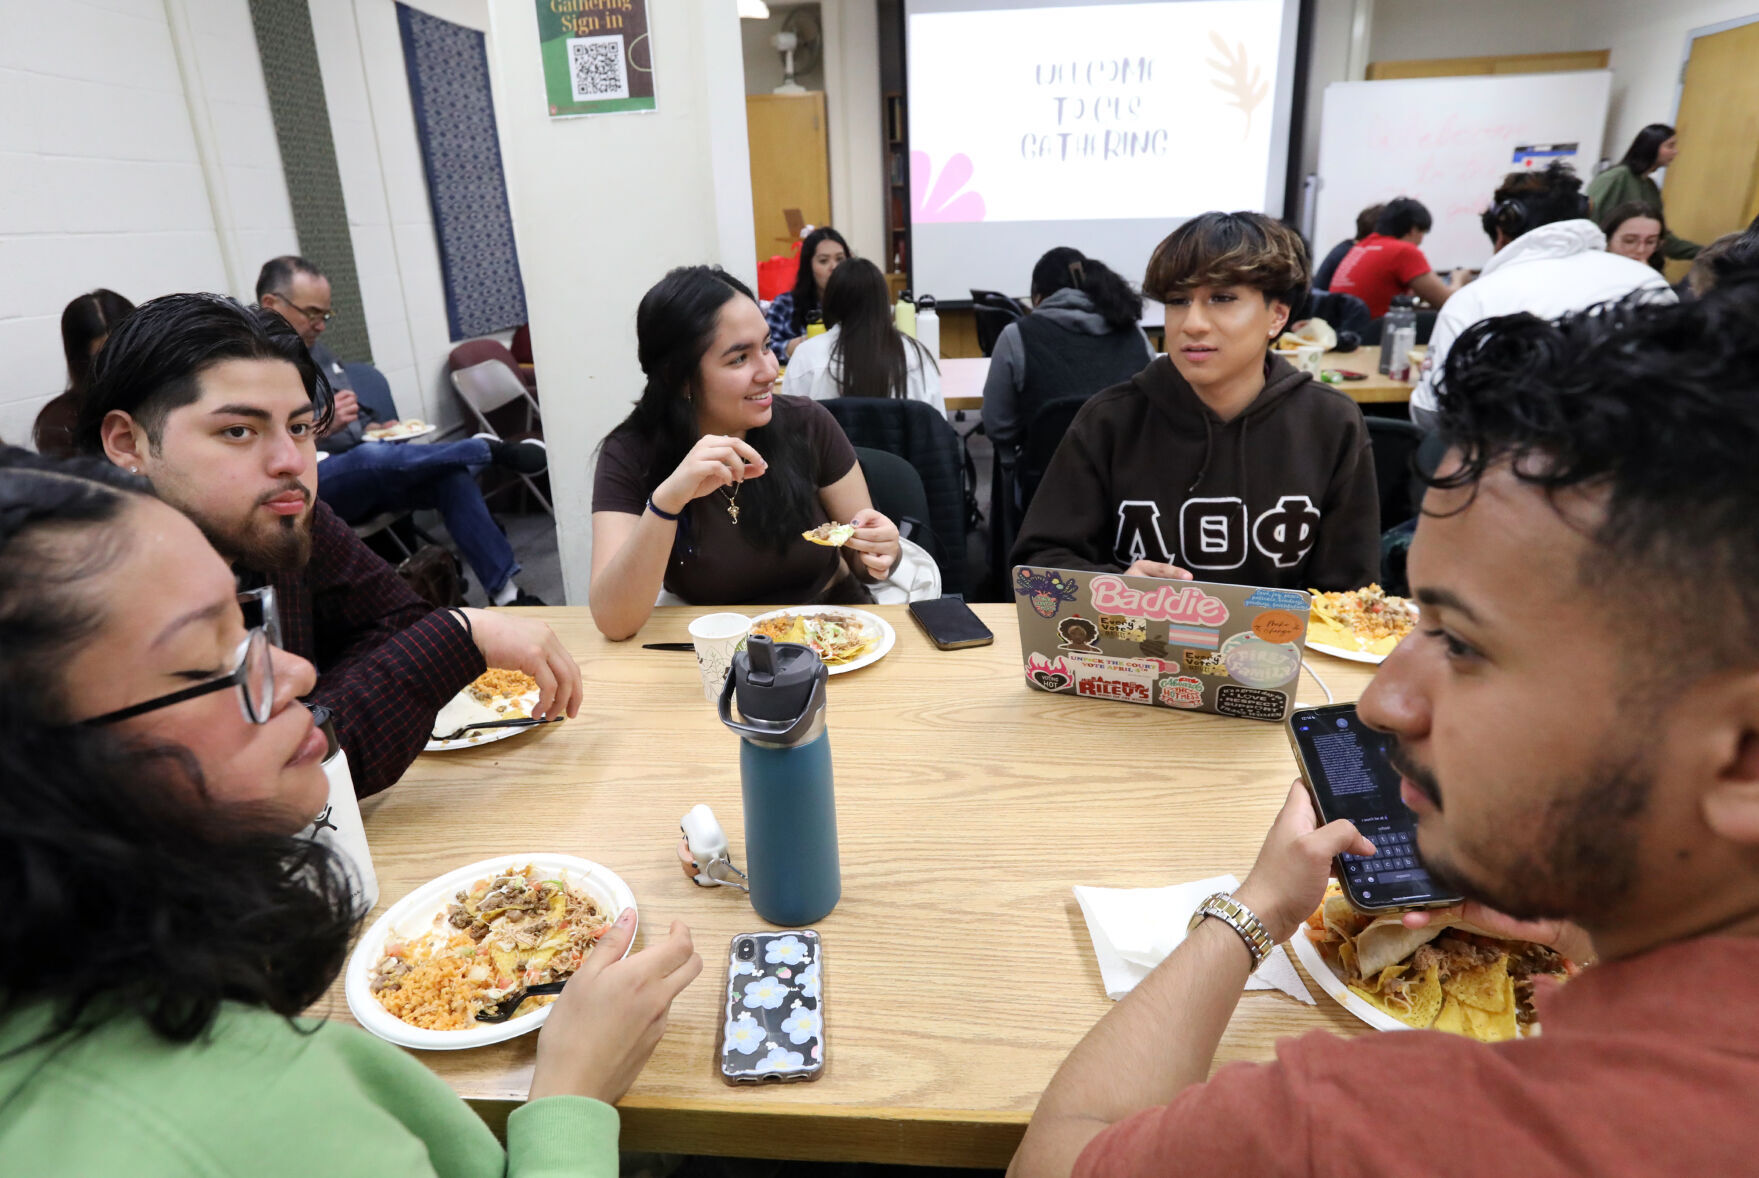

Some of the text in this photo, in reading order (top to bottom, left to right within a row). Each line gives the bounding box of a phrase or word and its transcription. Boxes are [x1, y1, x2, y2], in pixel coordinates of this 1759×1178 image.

[550, 0, 632, 13] Gathering
[1092, 577, 1220, 617] Baddie
[1100, 617, 1134, 630] Every
[1101, 624, 1127, 632] Vote
[1185, 651, 1220, 666] Every
[1185, 658, 1212, 667] Vote
[1126, 662, 1157, 670] COURT
[1043, 680, 1058, 689] HOT
[1079, 679, 1149, 699] RILEY'S
[1225, 697, 1279, 707] RESPECT
[1237, 693, 1267, 702] LOVE
[1223, 701, 1279, 712] SUPPORT
